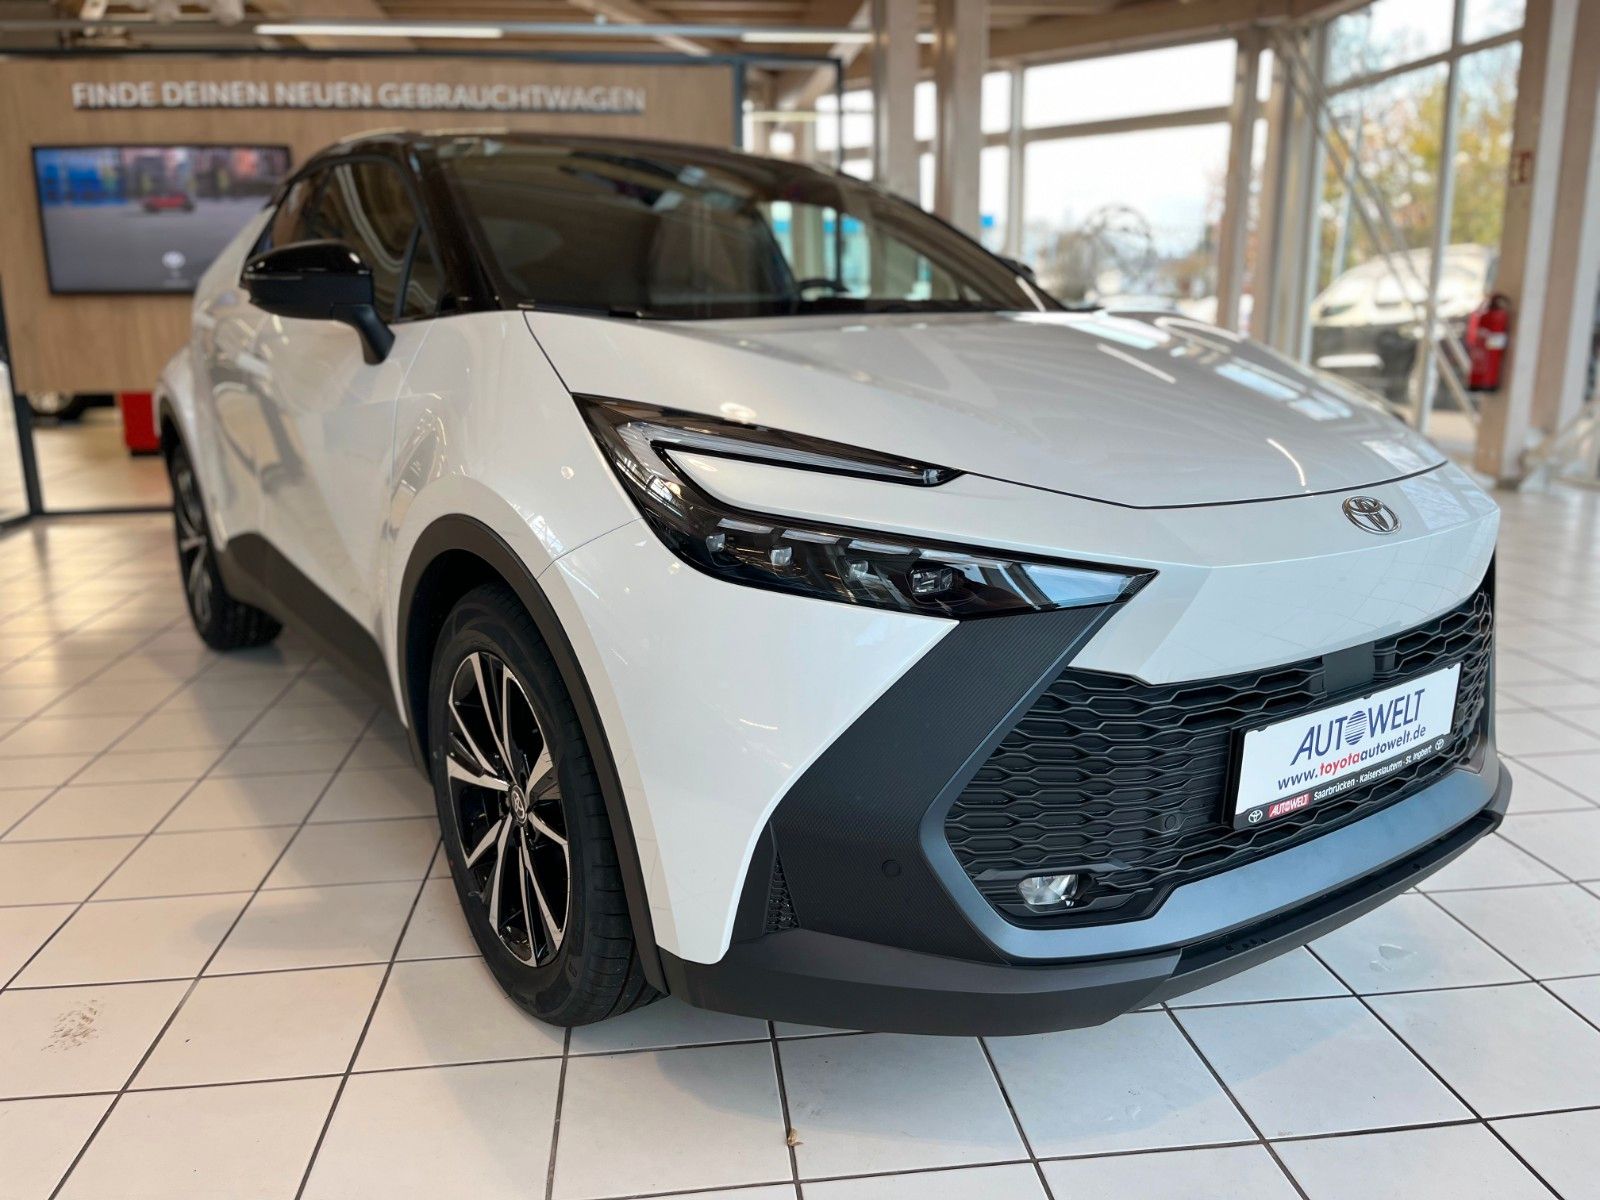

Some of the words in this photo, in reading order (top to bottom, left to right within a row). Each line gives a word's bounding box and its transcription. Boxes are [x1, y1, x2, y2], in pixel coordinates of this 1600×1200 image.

[72, 81, 156, 109] FINDE
[161, 80, 269, 109] DEINEN
[274, 81, 372, 109] NEUEN
[377, 83, 646, 112] GEBRAUCHTWAGEN
[1290, 688, 1425, 766] AUTOWELT
[1277, 725, 1426, 790] www.toyotaautowelt.de
[1313, 778, 1355, 801] Saarbrücken
